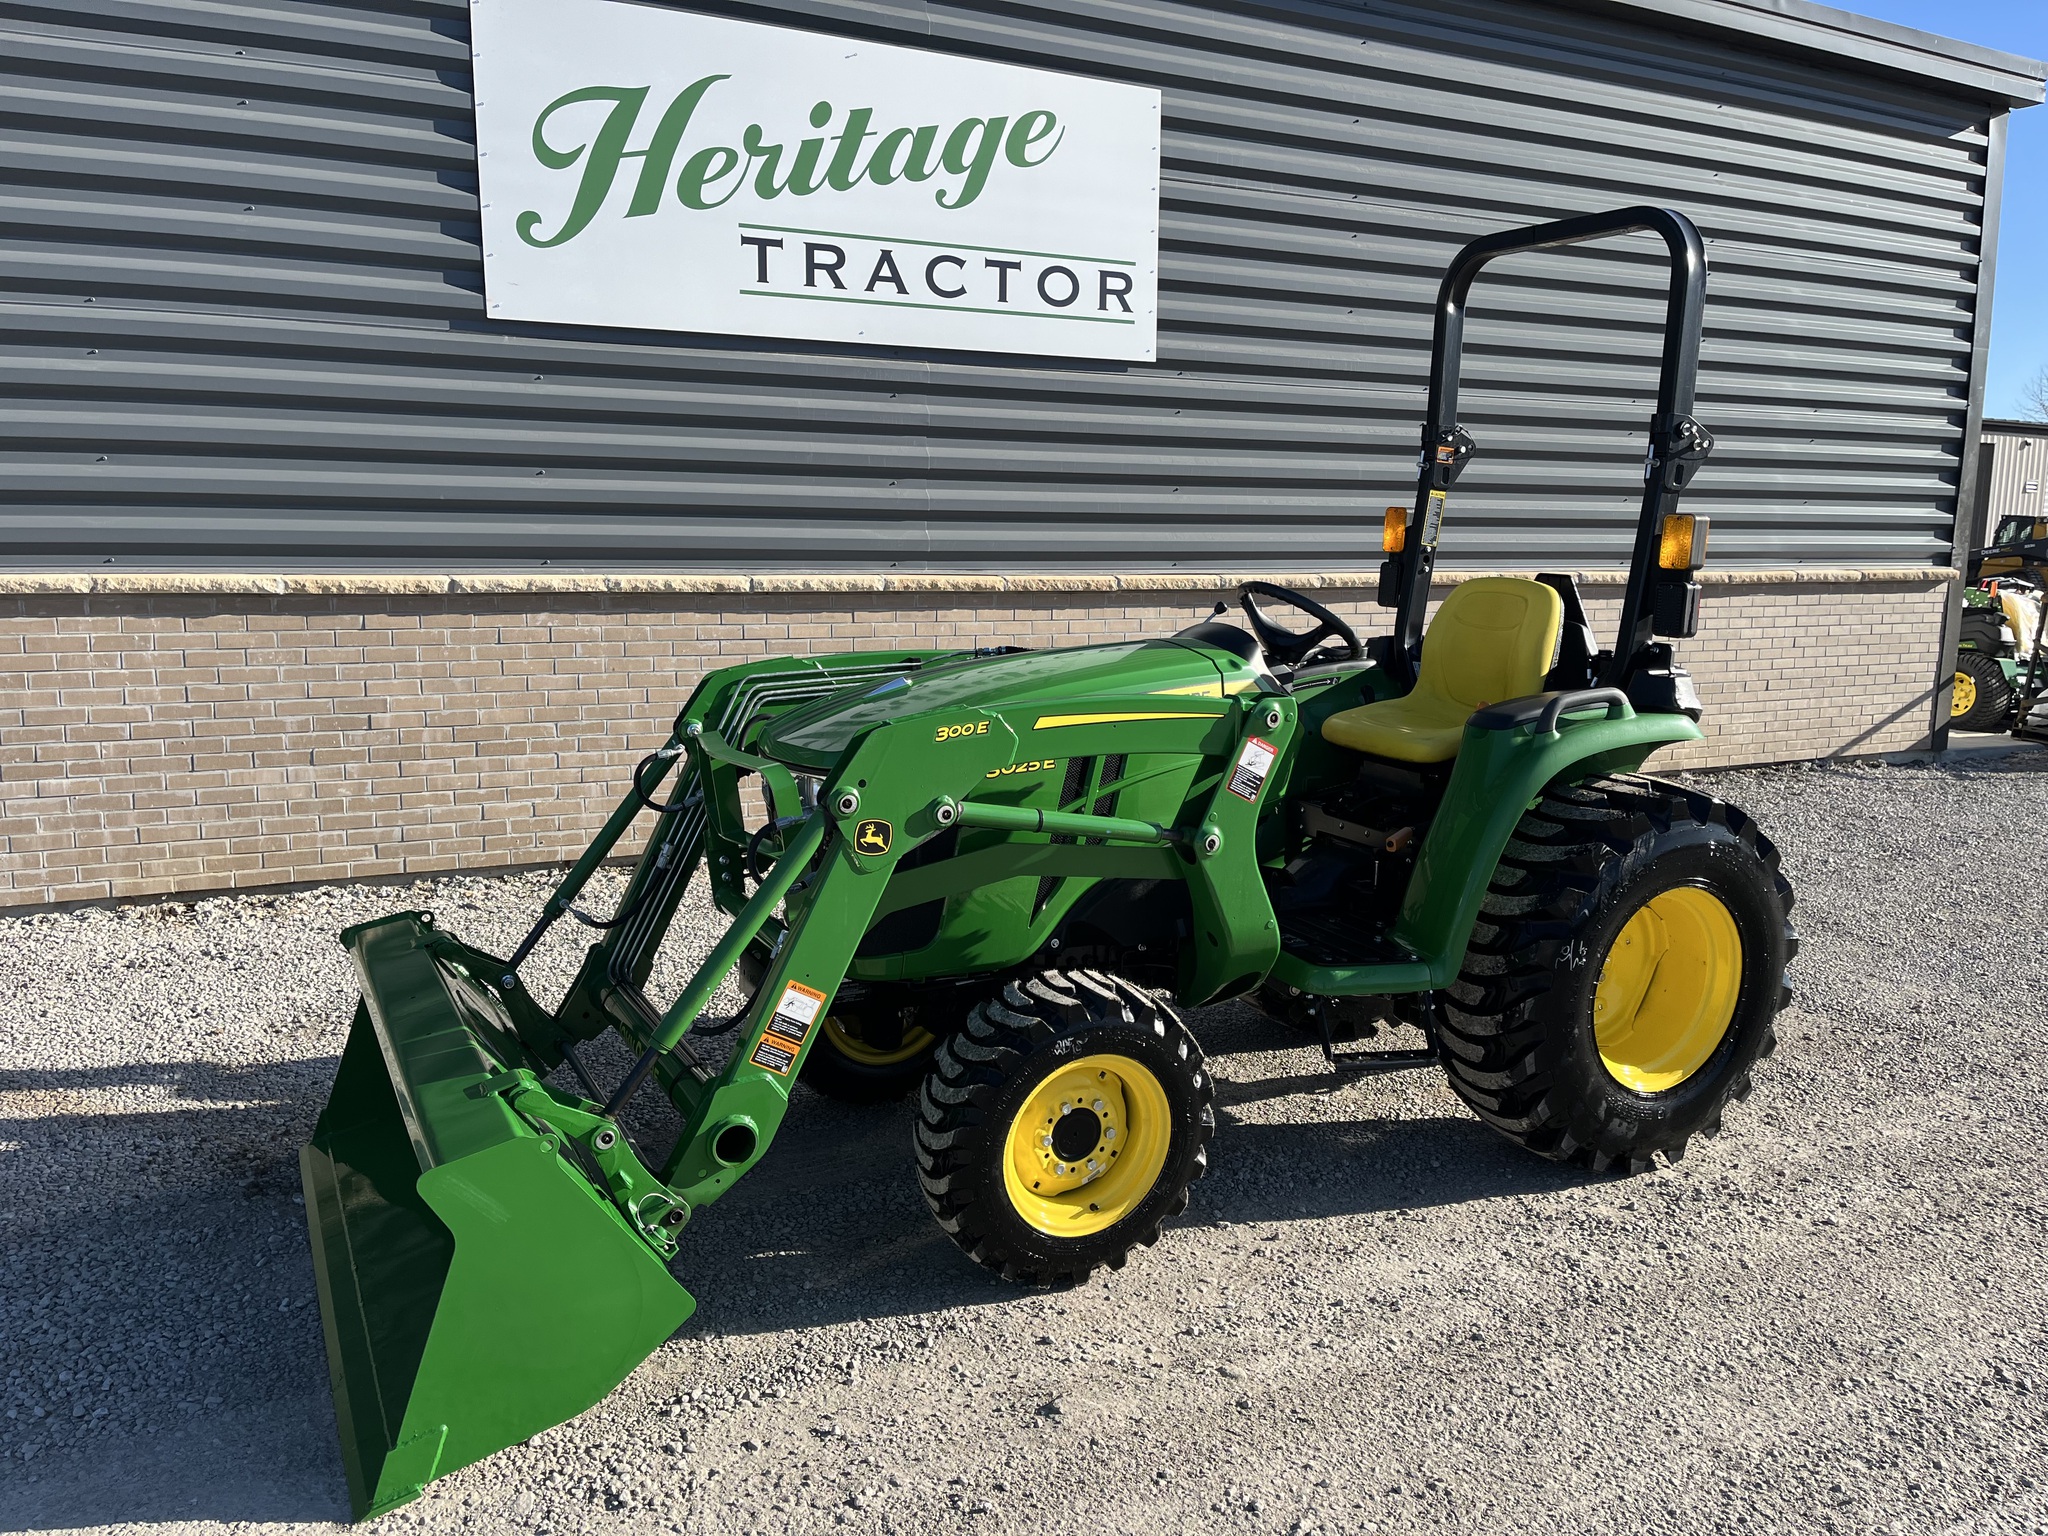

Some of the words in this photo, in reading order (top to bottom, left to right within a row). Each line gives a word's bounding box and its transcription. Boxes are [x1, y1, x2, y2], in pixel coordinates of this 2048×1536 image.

[516, 74, 1065, 248] Heritage
[740, 233, 1134, 314] TRACTOR
[797, 984, 822, 1000] WARNING
[771, 1038, 796, 1052] WARNING
